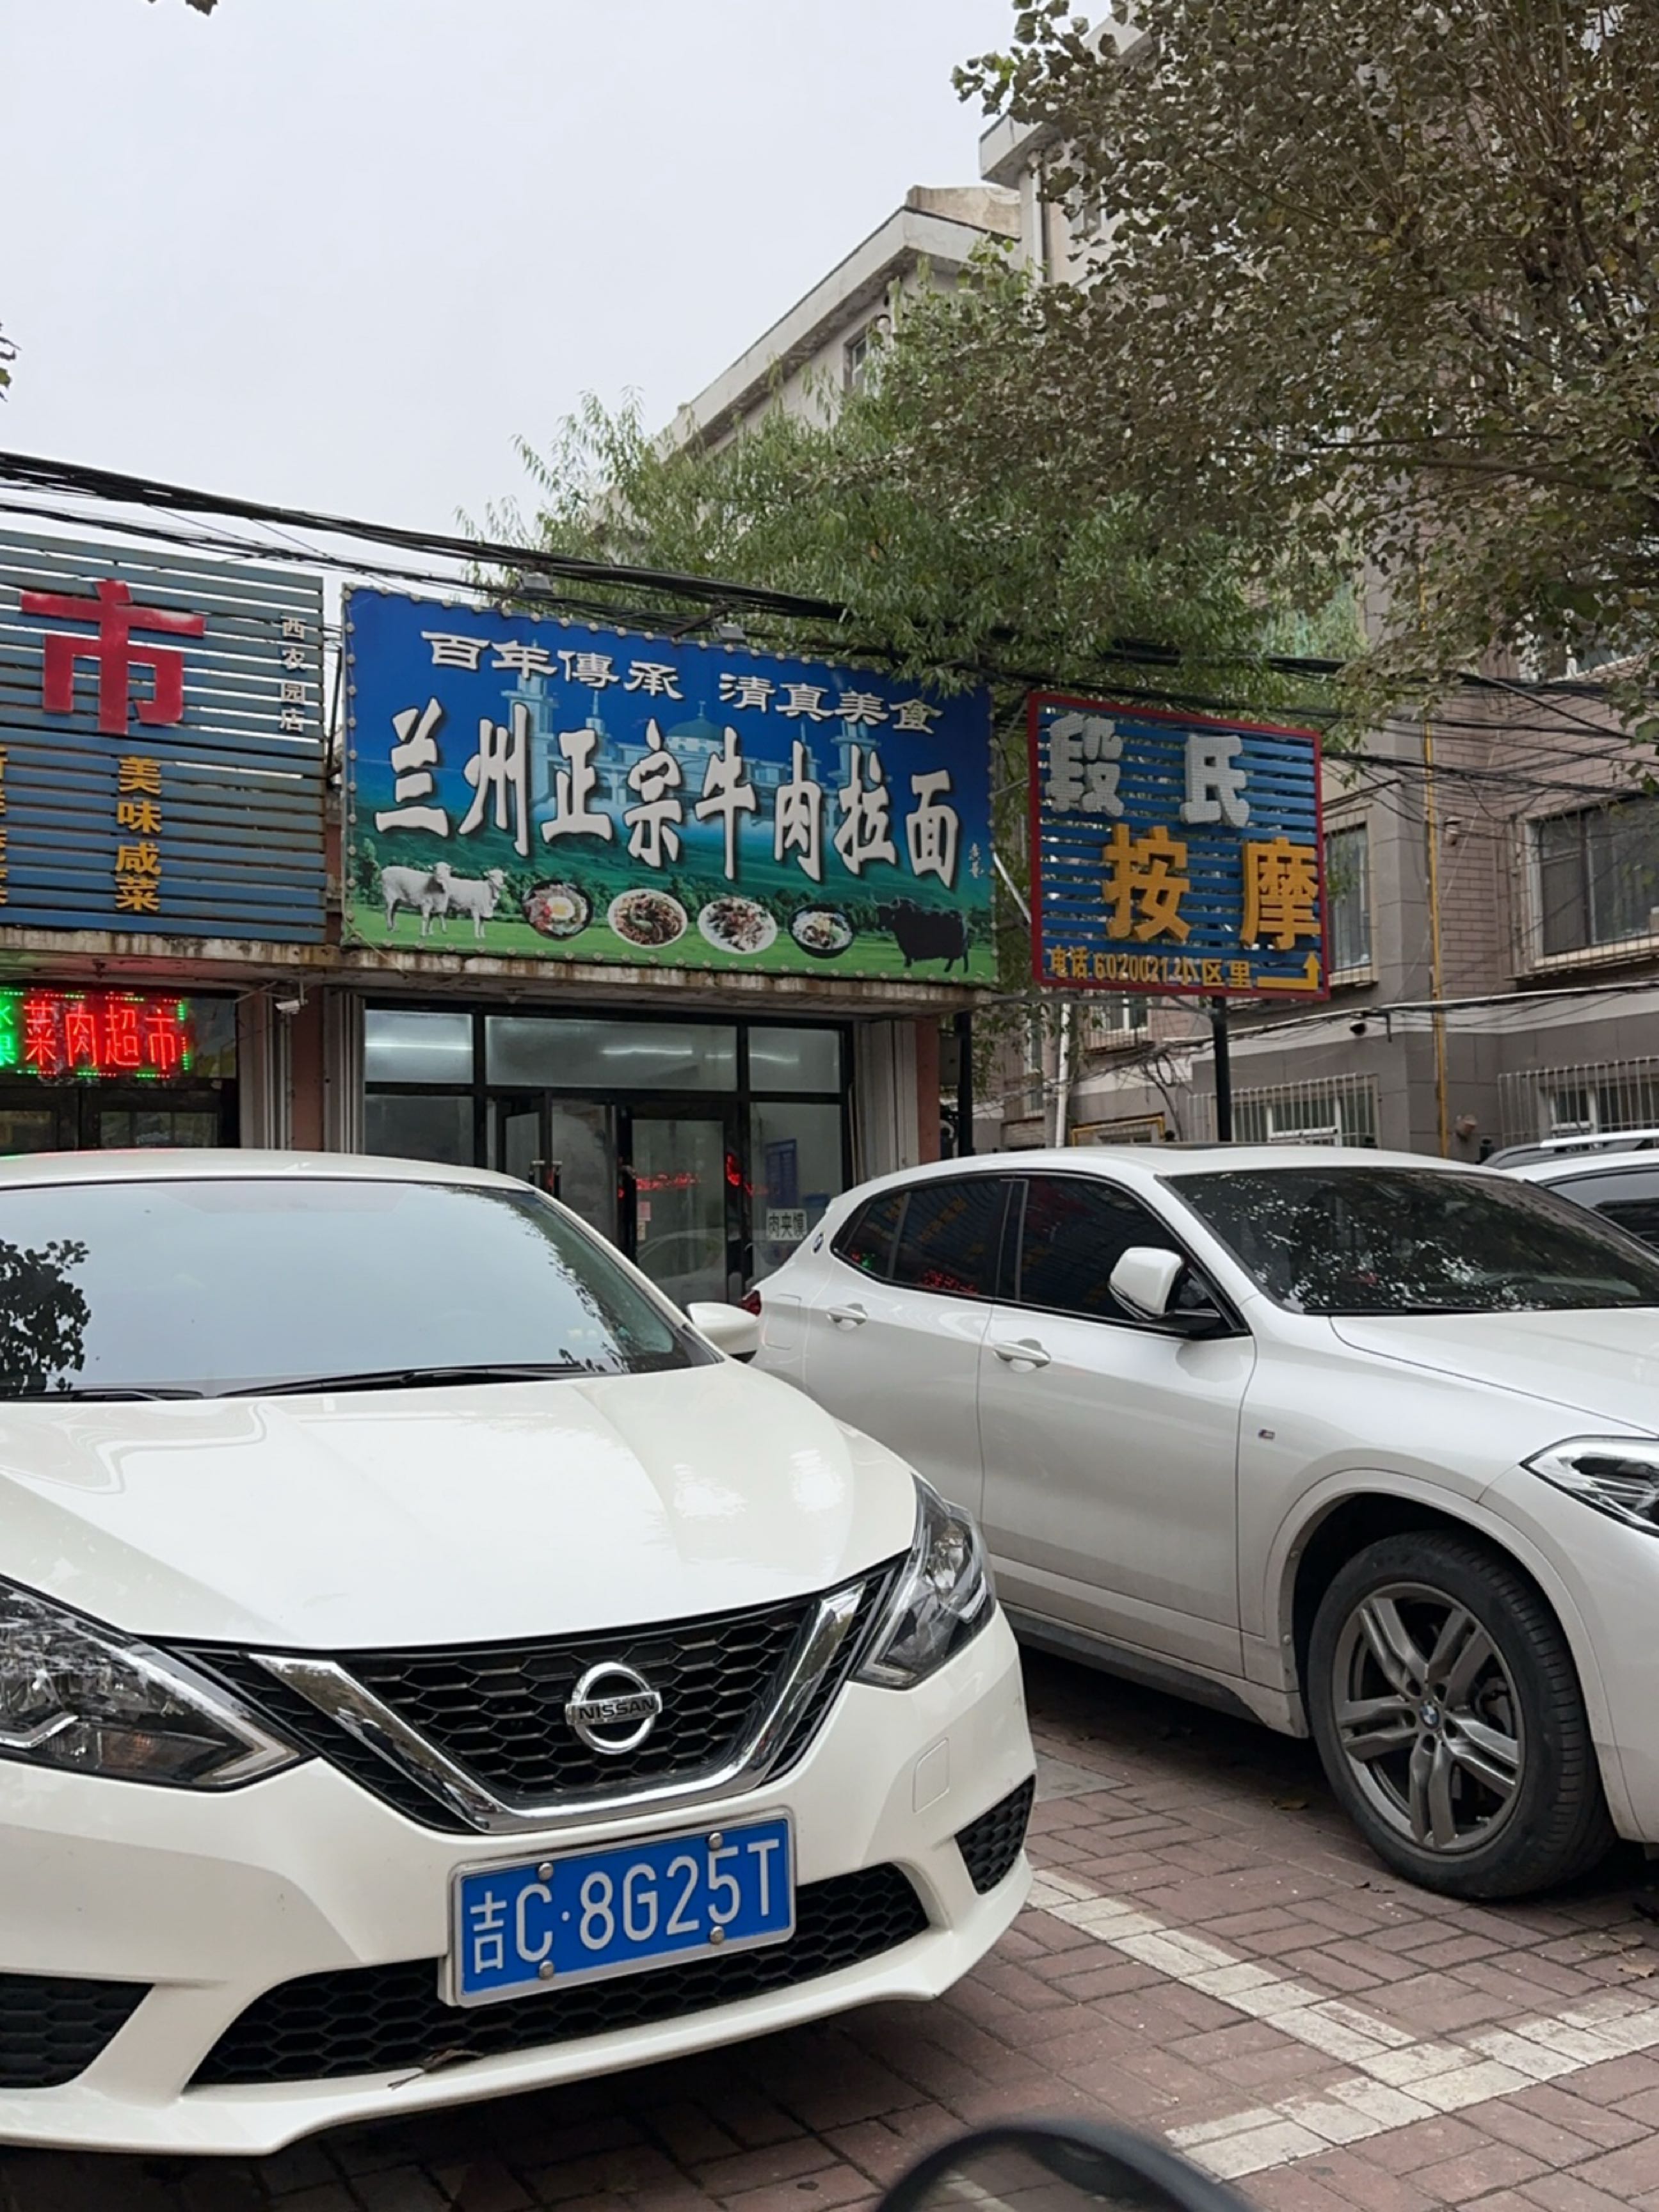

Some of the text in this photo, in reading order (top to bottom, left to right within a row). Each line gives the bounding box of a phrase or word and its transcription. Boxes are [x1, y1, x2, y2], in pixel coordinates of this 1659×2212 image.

[19, 580, 207, 734] 市
[420, 631, 943, 734] 百年傳承 清真美食
[115, 756, 162, 911] 美味咸菜
[375, 696, 959, 888] 兰州正宗牛肉拉面
[1102, 822, 1322, 950] 按摩
[23, 1000, 177, 1070] 菜肉超市
[579, 1697, 655, 1720] NISSAN
